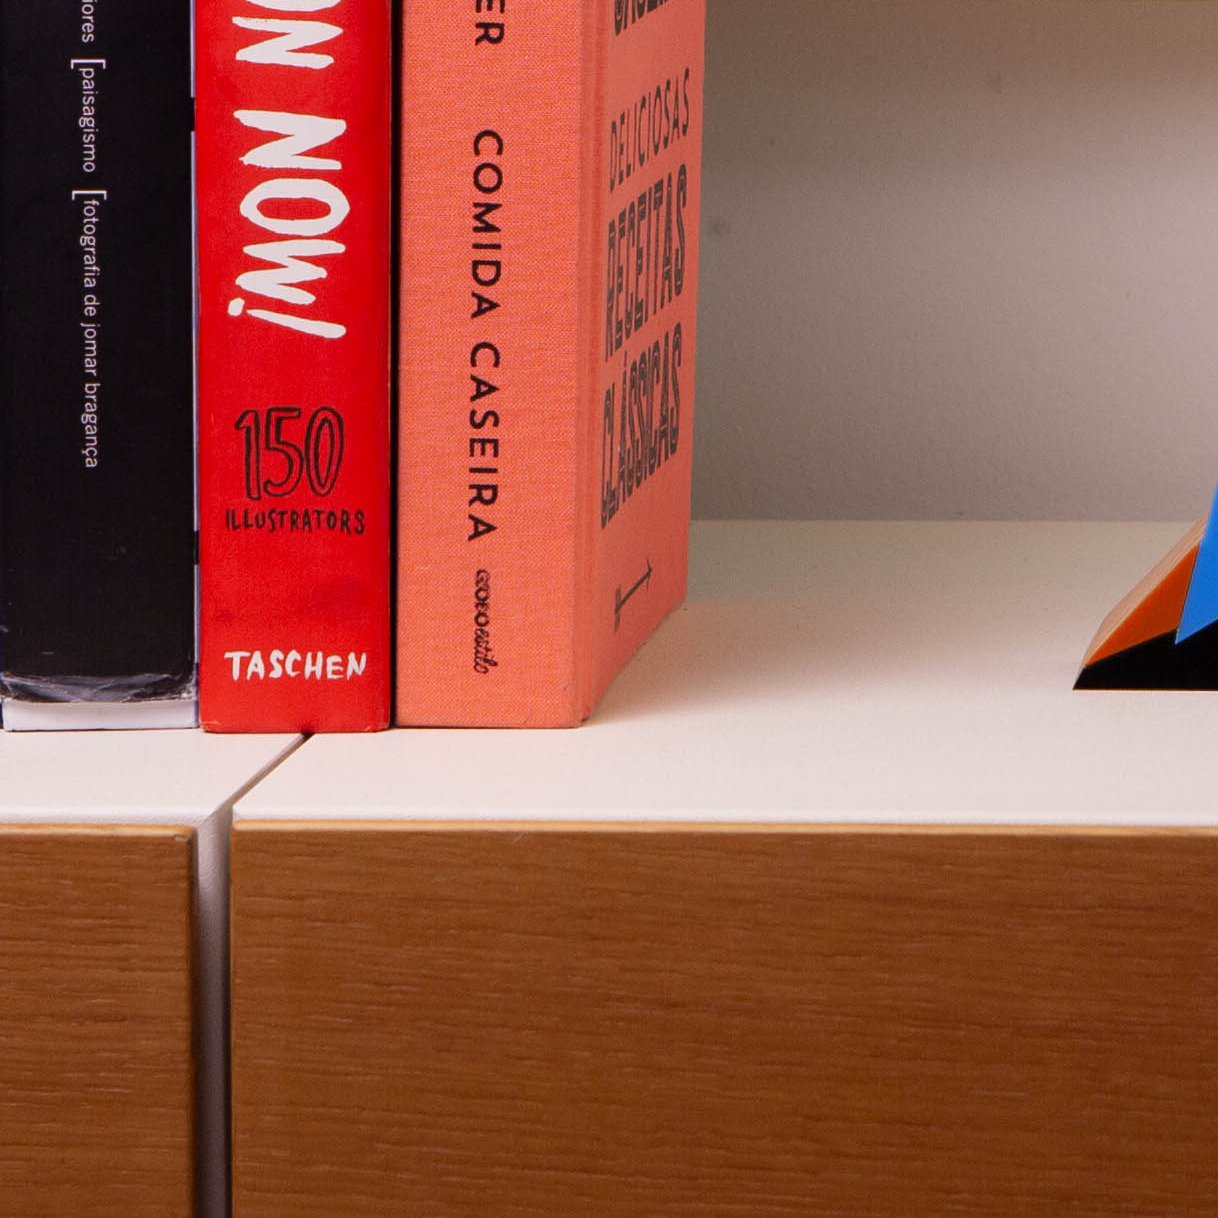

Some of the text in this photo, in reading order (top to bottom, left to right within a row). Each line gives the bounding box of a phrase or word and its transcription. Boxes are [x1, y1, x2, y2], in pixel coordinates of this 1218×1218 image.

[609, 67, 690, 194] DELICIOSAS
[227, 108, 350, 339] NOW!
[471, 129, 504, 319] COMIDA
[605, 163, 688, 362] RECEITAS
[80, 323, 101, 377] jomar
[83, 293, 101, 318] de
[81, 383, 102, 469] bragança
[234, 406, 345, 501] 150
[467, 341, 501, 542] CASEIRA
[601, 321, 683, 530] CLÁSSICAS
[225, 506, 366, 535] ILLUSTRATORS
[223, 650, 368, 682] TASCHEN
